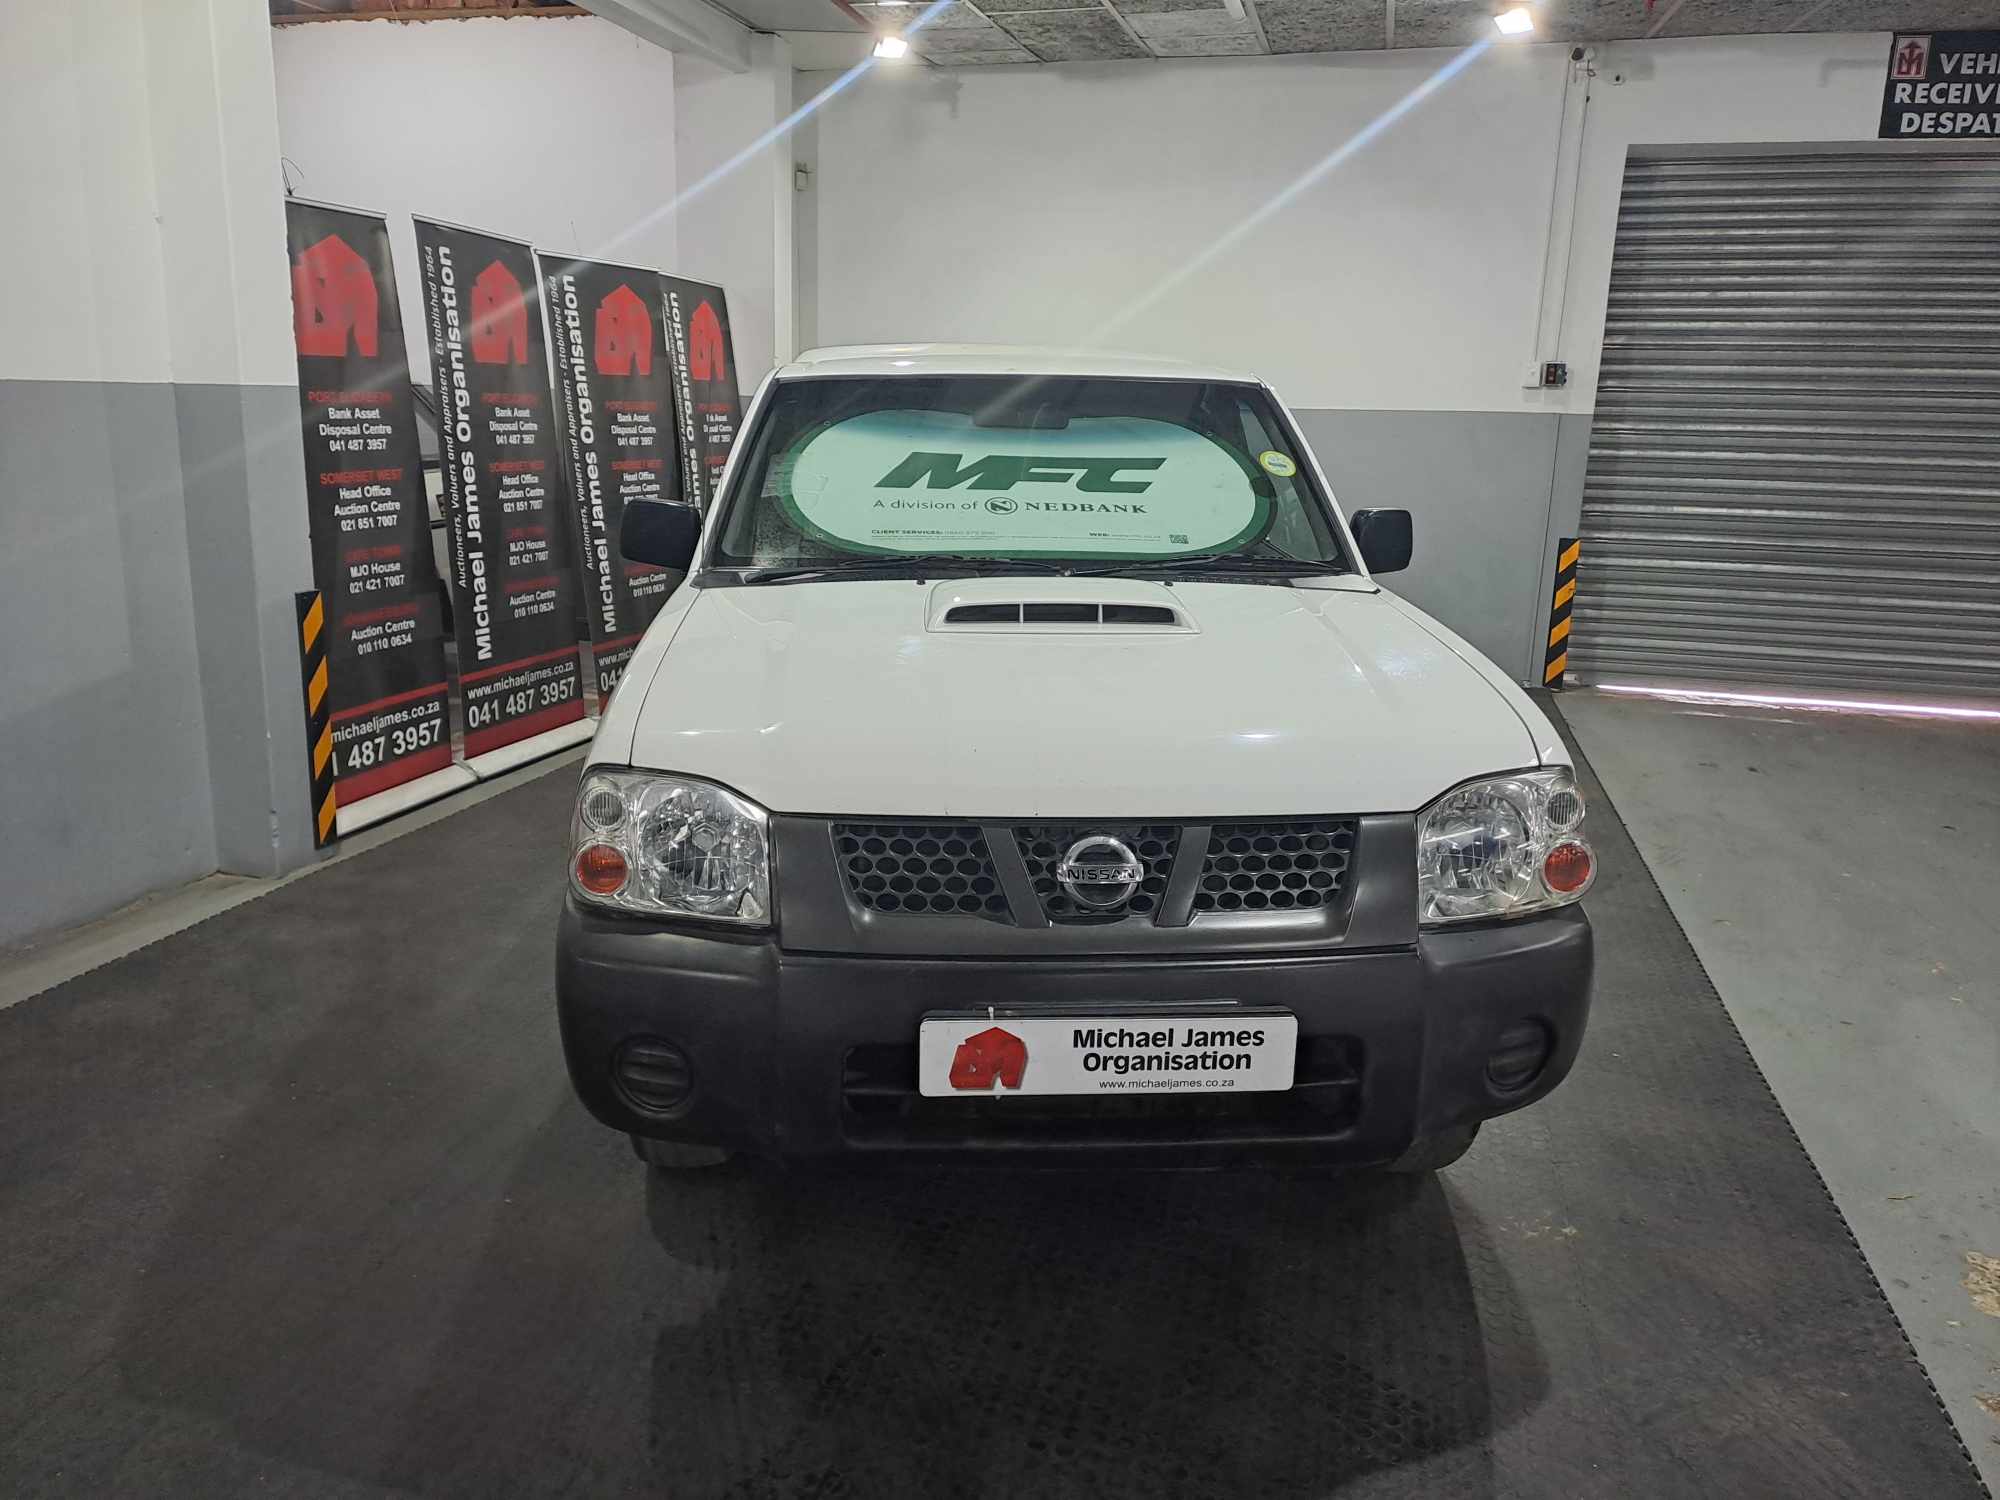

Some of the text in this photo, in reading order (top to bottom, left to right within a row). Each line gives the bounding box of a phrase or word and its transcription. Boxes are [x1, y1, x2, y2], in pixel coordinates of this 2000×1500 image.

[1940, 53, 2000, 75] VEH
[1894, 82, 2000, 104] RECEIV
[554, 306, 569, 370] Established
[670, 292, 694, 441] Organisation
[328, 408, 380, 420] Bank Asset
[423, 245, 467, 588] Auctioneers, Valuers and Appraisers Established 1964
[562, 378, 576, 437] Appraisers
[319, 423, 392, 437] Disposal Centre
[329, 438, 387, 452] 041 487 3957
[438, 246, 493, 660] Michael James Organisation
[563, 275, 616, 633] Michael James Organisation
[569, 438, 579, 459] and
[574, 462, 585, 501] Valuers
[873, 451, 1168, 494] MFC
[339, 485, 391, 499] Head Office
[334, 501, 400, 516] Auction Centre
[873, 499, 1148, 514] A division of NEDBANK
[341, 519, 356, 531] 021
[580, 505, 594, 570] Auctioneers,
[350, 562, 401, 578] MJO House
[349, 582, 363, 594] 021
[365, 579, 381, 591] 421
[351, 620, 415, 641] Auction Centre
[358, 633, 412, 655] 010 110 0634
[598, 647, 635, 667] www.mich
[467, 661, 574, 700] www.michaeljames.co.za
[468, 676, 576, 728] 041 487 3957
[331, 701, 440, 744] michaeljames.co.za
[348, 735, 386, 769] 487
[391, 718, 442, 755] 3957
[1067, 868, 1135, 881] NISSAN
[1072, 1028, 1265, 1050] Michael James
[1082, 1050, 1252, 1075] Organisation
[1099, 1078, 1235, 1090] www.michaeljames.co.za
